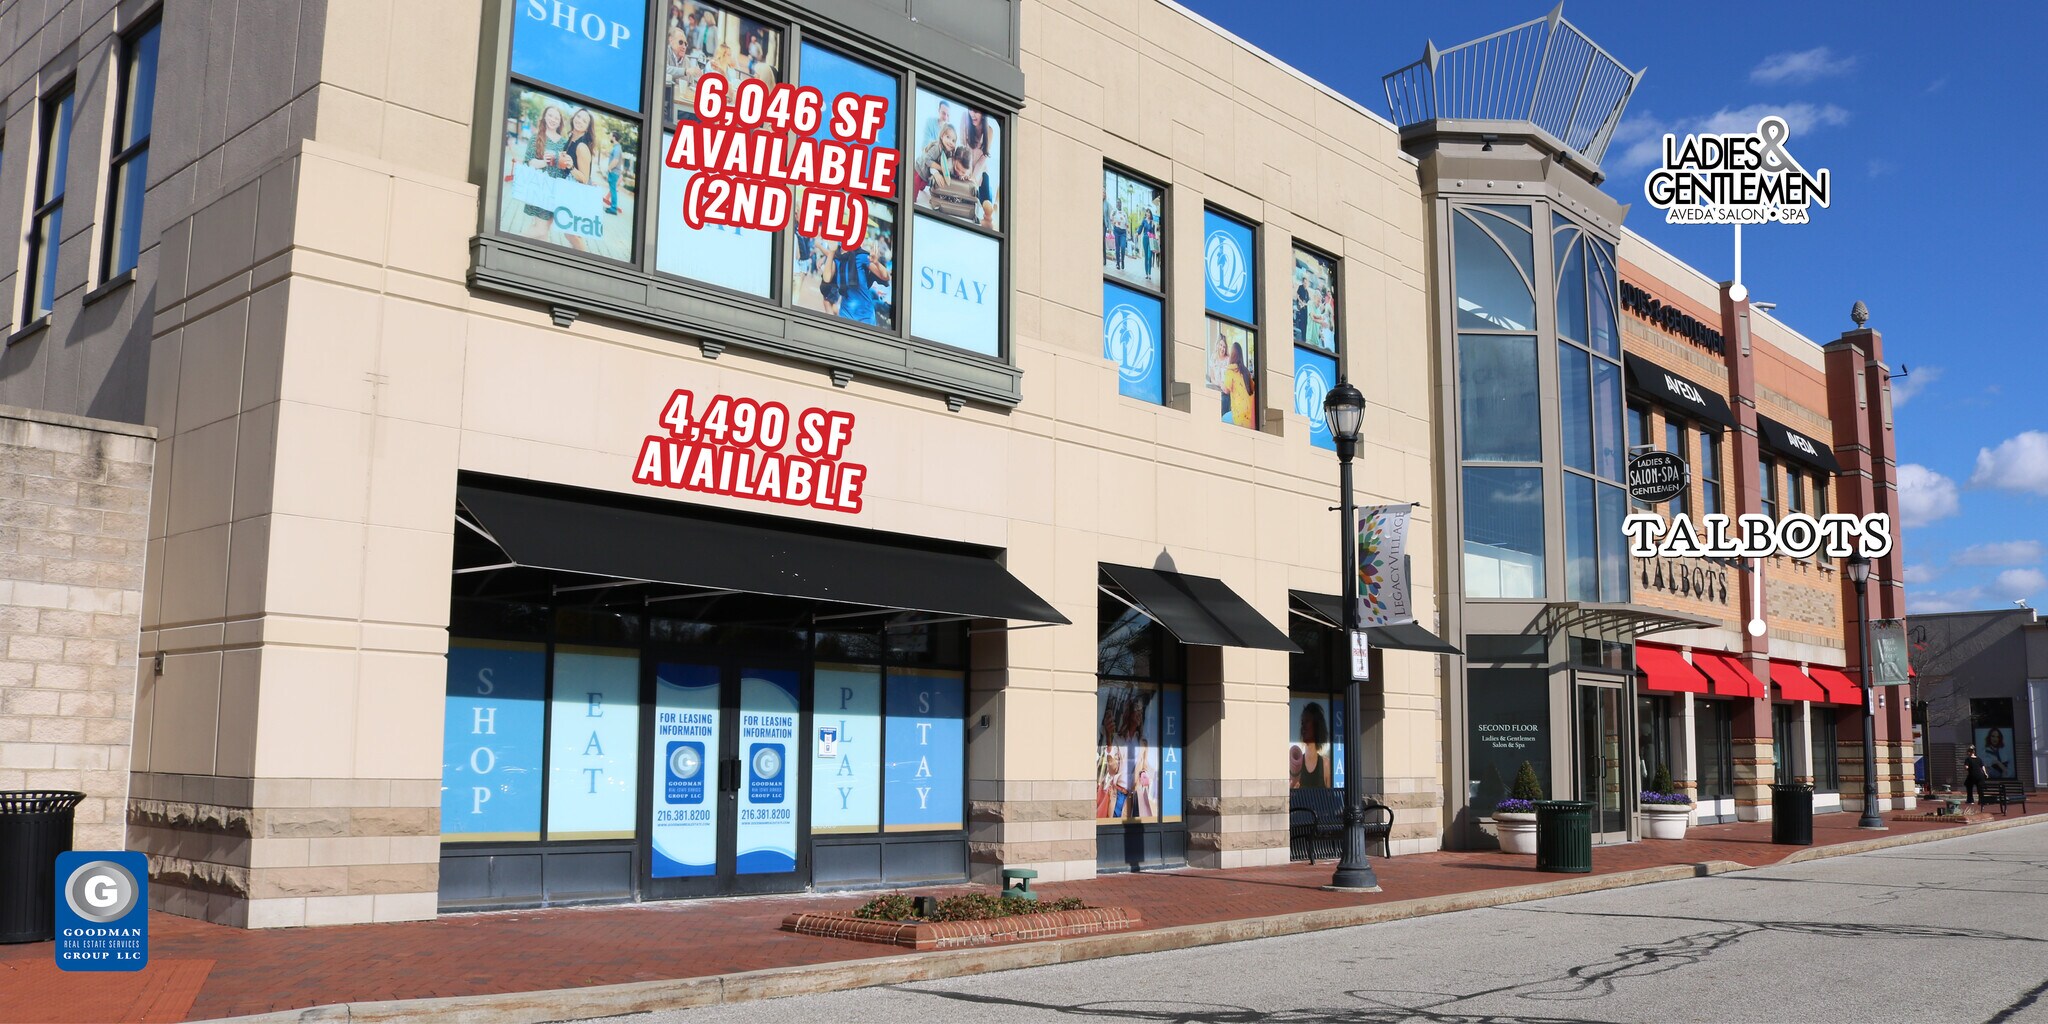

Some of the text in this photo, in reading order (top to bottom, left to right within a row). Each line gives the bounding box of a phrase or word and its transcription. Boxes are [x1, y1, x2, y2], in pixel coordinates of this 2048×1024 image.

[527, 0, 631, 49] SHOP
[920, 266, 988, 305] STAY
[1663, 373, 1706, 407] AVEDA
[1785, 430, 1819, 457] AVEDA
[1637, 456, 1672, 468] LADIES &
[1632, 484, 1680, 496] GENTLEMEN
[1637, 557, 1727, 602] TALBOTS
[660, 713, 713, 725] FOR LEASING
[744, 716, 793, 727] FOR LEASING
[1478, 724, 1538, 732] SECOND FLOOR
[470, 668, 497, 814] SHOP
[659, 725, 713, 737] INFORMATION
[743, 727, 792, 739] INFORMATION
[582, 692, 604, 794] EAT
[836, 687, 854, 810] PLAY
[915, 691, 932, 810] STAY
[1164, 716, 1177, 790] EAT
[1515, 742, 1525, 750] Spa
[657, 809, 711, 822] 216.381.8200
[741, 808, 791, 820] 216.381.8200
